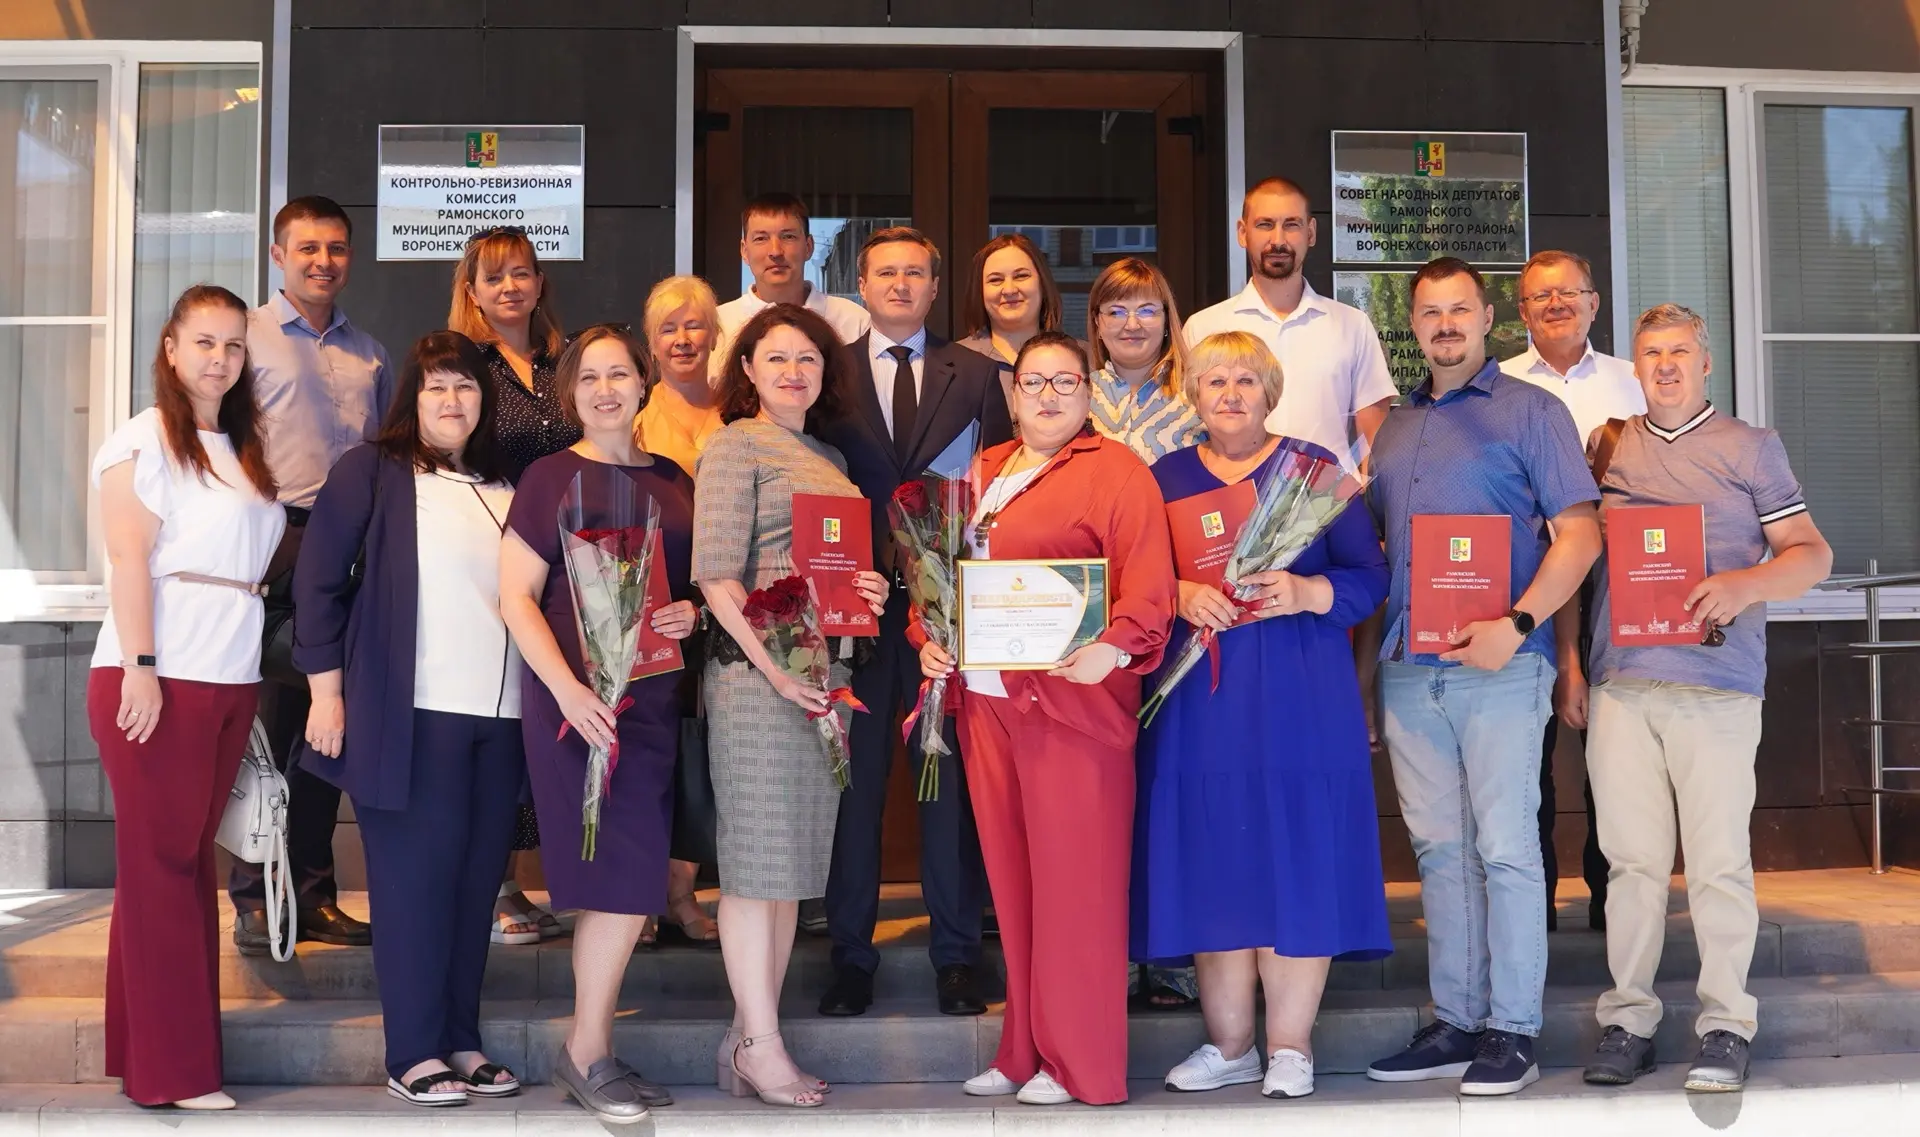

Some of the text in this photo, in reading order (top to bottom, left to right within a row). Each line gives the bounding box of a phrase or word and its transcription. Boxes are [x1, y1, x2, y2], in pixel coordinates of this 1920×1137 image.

[391, 178, 572, 188] КОНТРОЛЬНО-РЕВИЗИОННАЯ
[446, 193, 516, 204] КОМИССИЯ
[1340, 189, 1520, 201] СОВЕТ НАРОДНЫХ ДЕПУТАТОВ
[438, 209, 524, 220] РАМОНСКОГО
[1390, 207, 1472, 217] РАМОНСКОГО
[1347, 222, 1516, 235] МУНИЦИПАЛЬНОГО РАЙОНА
[1357, 239, 1507, 252] ВОРОНЕЖСКОЙ ОБЛАСТИ
